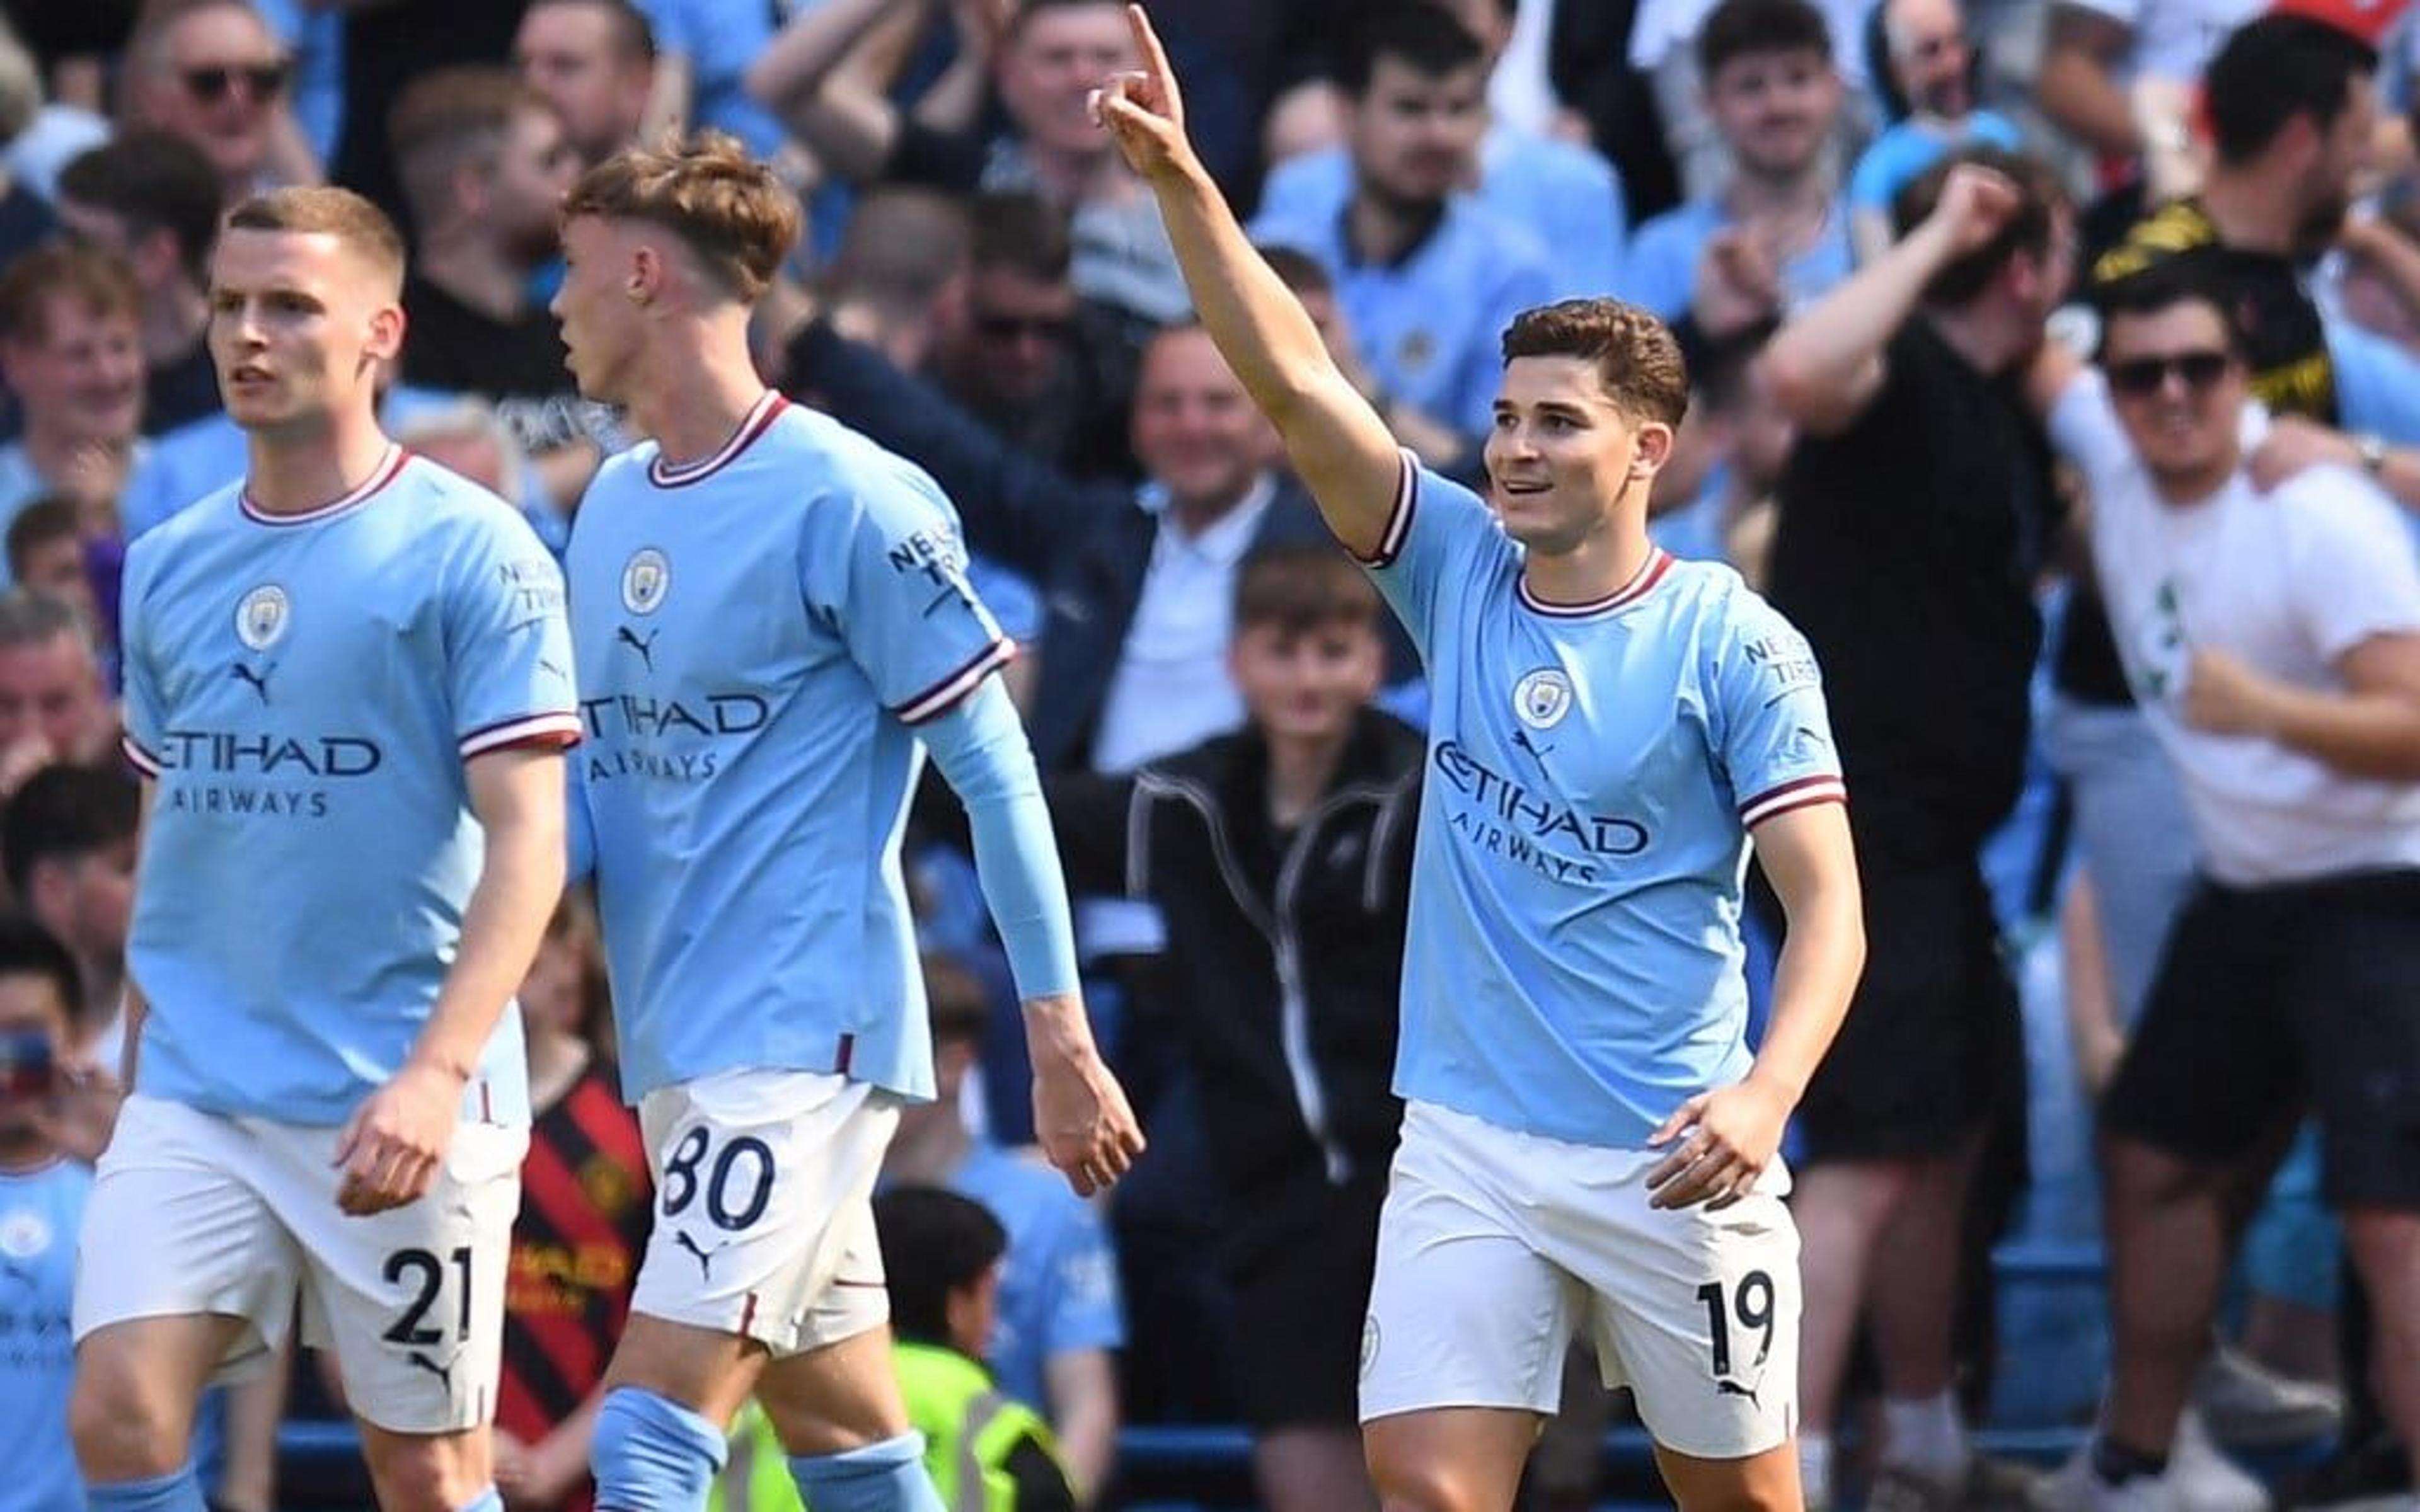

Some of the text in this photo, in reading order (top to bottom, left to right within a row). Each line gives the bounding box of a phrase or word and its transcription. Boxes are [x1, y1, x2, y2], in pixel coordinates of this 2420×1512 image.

[170, 787, 327, 818] AIRWAYS
[1434, 740, 1649, 856] ETIHAD
[1451, 811, 1598, 883] AIRWAYS
[663, 1125, 776, 1231] 80
[382, 1246, 471, 1345] 21
[1697, 1269, 1775, 1376] 19
